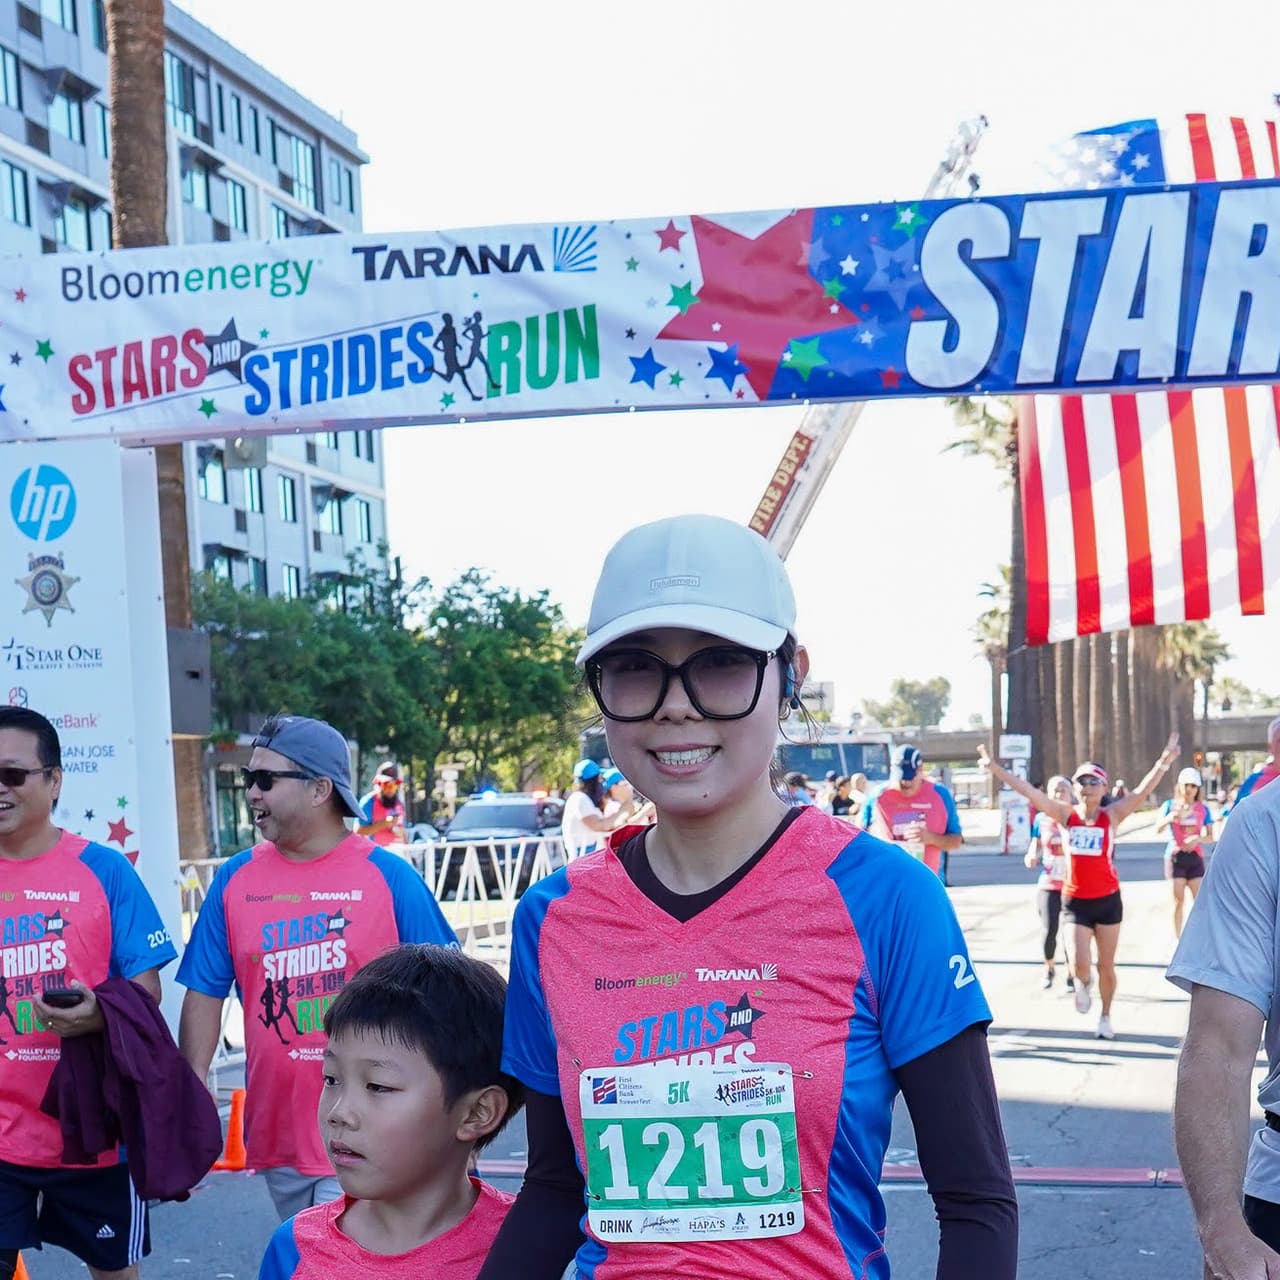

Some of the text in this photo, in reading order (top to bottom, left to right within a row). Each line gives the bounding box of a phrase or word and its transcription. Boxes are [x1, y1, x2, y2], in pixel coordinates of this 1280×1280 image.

[61, 243, 544, 303] Bloomenergy TARANA
[69, 303, 601, 416] STARS AND STRIDES RUN
[17, 463, 70, 541] hp
[750, 486, 783, 532] FIRE
[25, 644, 103, 661] STAR ONE
[88, 745, 115, 758] JOSE
[62, 761, 99, 773] WATER
[24, 889, 68, 901] TARANA
[47, 918, 63, 930] AND
[260, 911, 328, 951] STARS
[263, 938, 347, 982] STRIDES
[595, 967, 761, 991] Bloomenergy TARANA
[614, 1000, 728, 1063] STARS
[729, 1008, 753, 1027] AND
[668, 1081, 690, 1105] 5K
[731, 1077, 756, 1091] STARS
[732, 1086, 765, 1103] STRIDES
[765, 1095, 782, 1106] RUN
[599, 1118, 786, 1200] 1219
[600, 1219, 633, 1233] DRINK
[688, 1220, 726, 1230] HAPA'S
[759, 1211, 795, 1229] 1219
